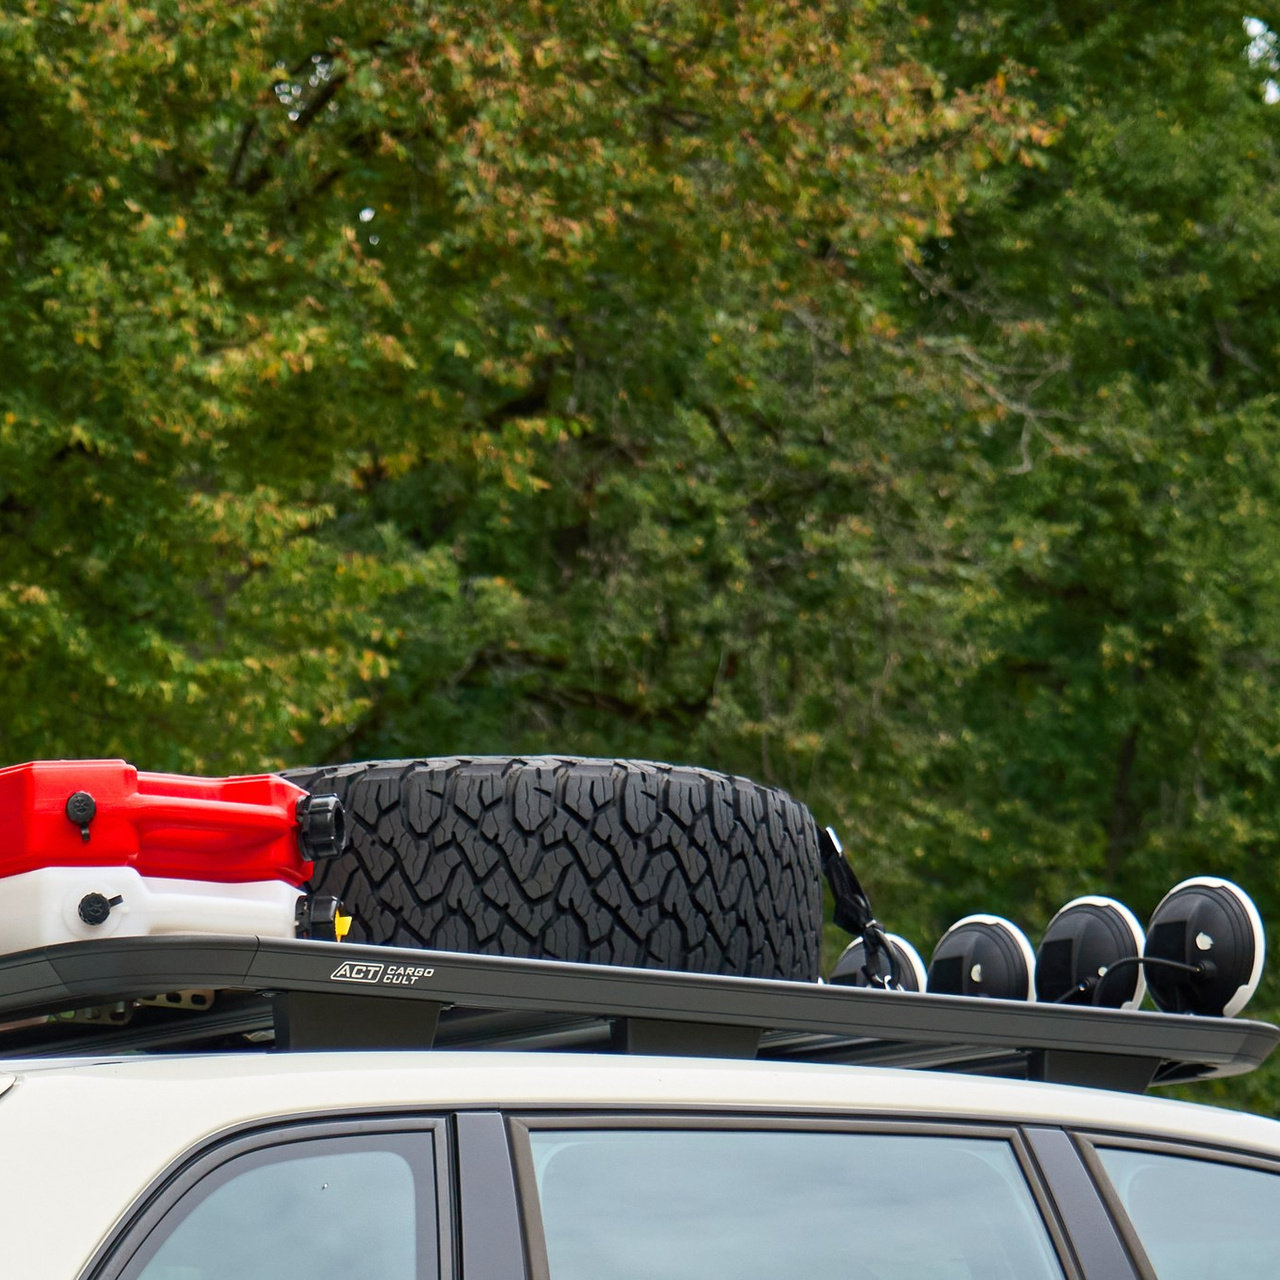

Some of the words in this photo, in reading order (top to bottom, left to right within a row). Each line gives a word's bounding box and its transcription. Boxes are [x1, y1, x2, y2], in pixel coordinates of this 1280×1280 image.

[336, 964, 380, 979] ACT
[386, 965, 435, 978] CARGO
[382, 974, 419, 985] CULT
